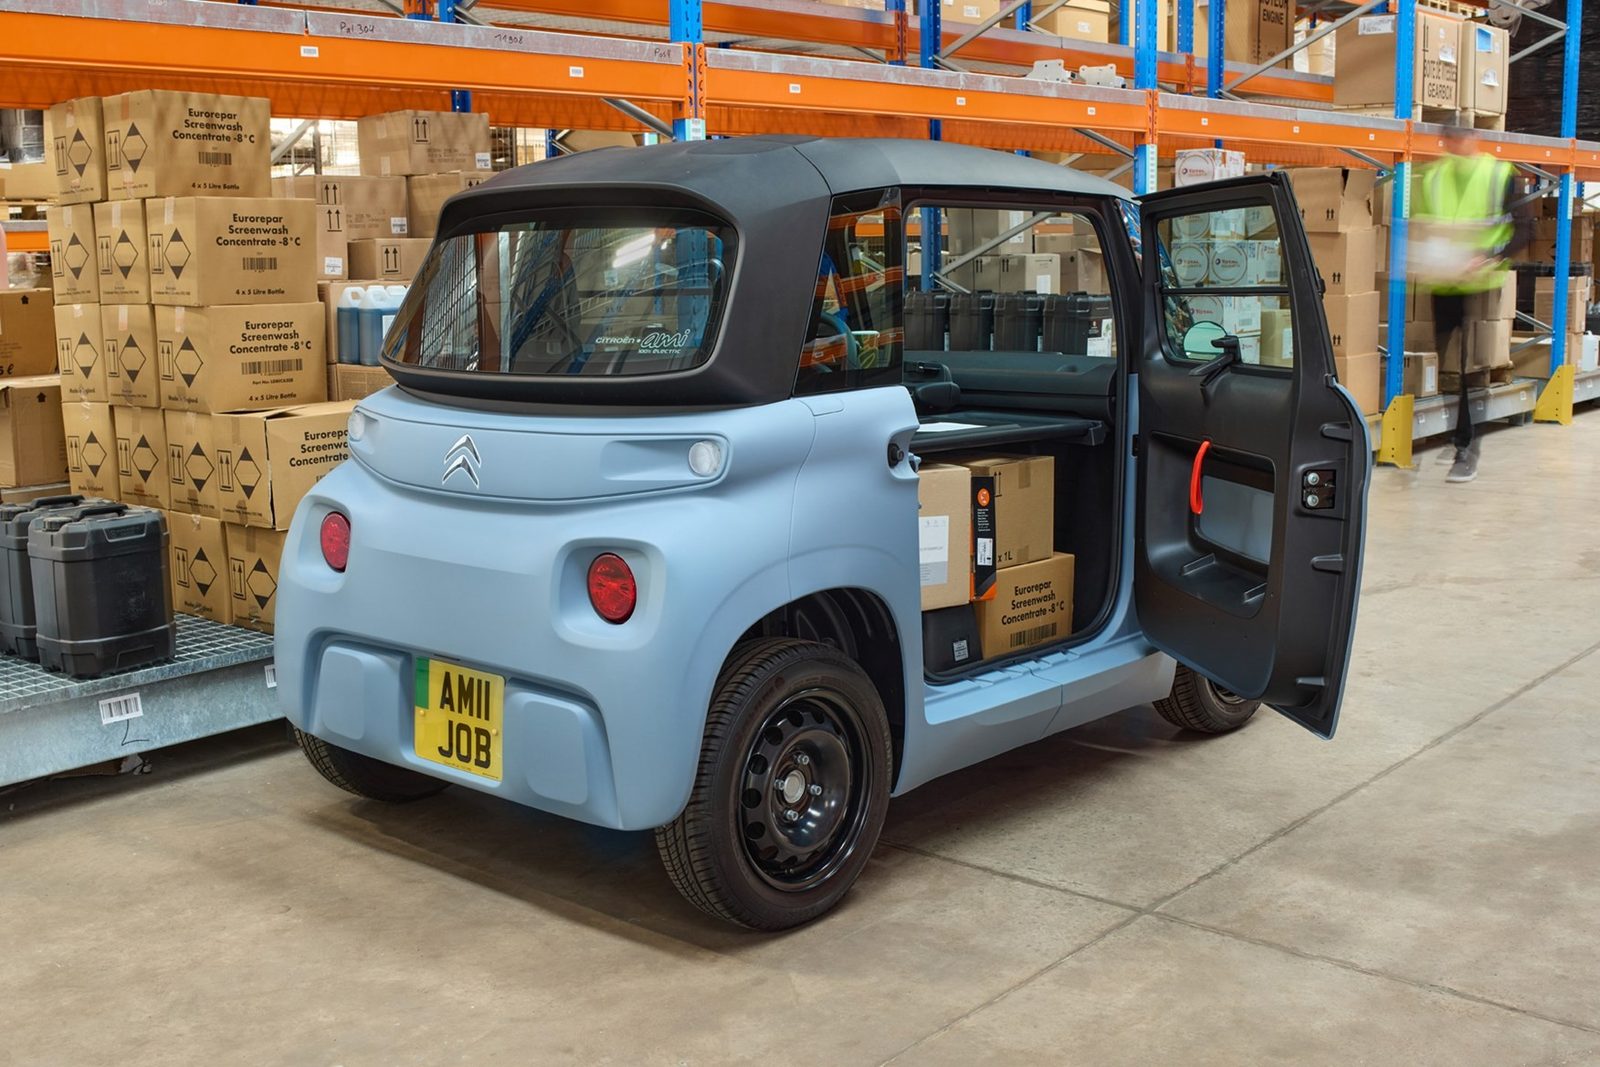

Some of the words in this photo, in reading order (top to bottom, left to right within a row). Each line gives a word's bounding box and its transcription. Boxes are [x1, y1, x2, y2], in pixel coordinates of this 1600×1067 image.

[1262, 9, 1284, 25] ENGINE
[188, 108, 237, 121] Eurorepar
[184, 119, 243, 132] Screenwash
[172, 130, 231, 142] Concentrate
[232, 213, 283, 225] Eurorepar
[228, 225, 289, 235] Screenwash
[216, 236, 277, 246] Concentrate
[245, 321, 294, 331] Eurorepar
[241, 330, 299, 342] Screenwash
[640, 328, 691, 349] ami
[229, 344, 288, 354] Concentrate
[304, 429, 348, 441] Eurorepa
[301, 441, 348, 454] Screenwa
[289, 452, 349, 467] Concentrate
[1004, 550, 1013, 561] 1L
[1014, 581, 1052, 596] Eurorepar
[1011, 590, 1056, 610] Screenwash
[1001, 607, 1047, 625] Concentrate
[437, 719, 492, 769] JOB
